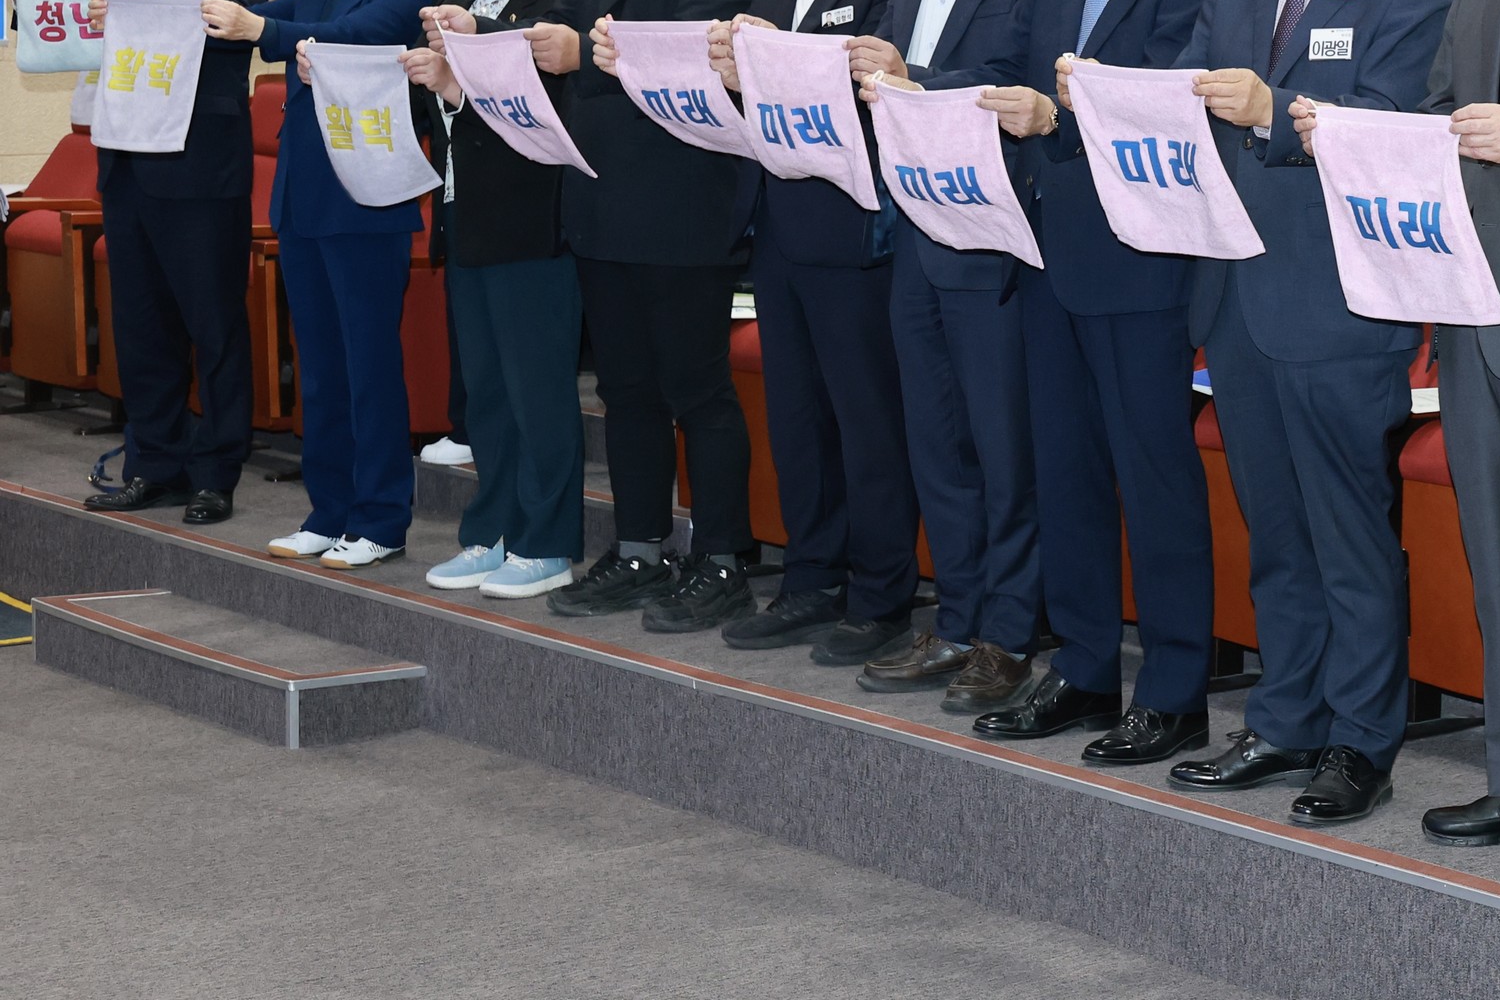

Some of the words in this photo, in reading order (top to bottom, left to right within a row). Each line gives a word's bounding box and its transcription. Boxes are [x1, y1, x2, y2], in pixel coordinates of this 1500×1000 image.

[107, 45, 181, 97] 활력
[1312, 40, 1349, 57] 이광일
[324, 102, 395, 153] 활력
[641, 88, 725, 128] 미래
[756, 102, 844, 151] 미래
[894, 164, 995, 207] 미래
[1111, 136, 1205, 194] 미래
[1345, 194, 1454, 256] 미래
